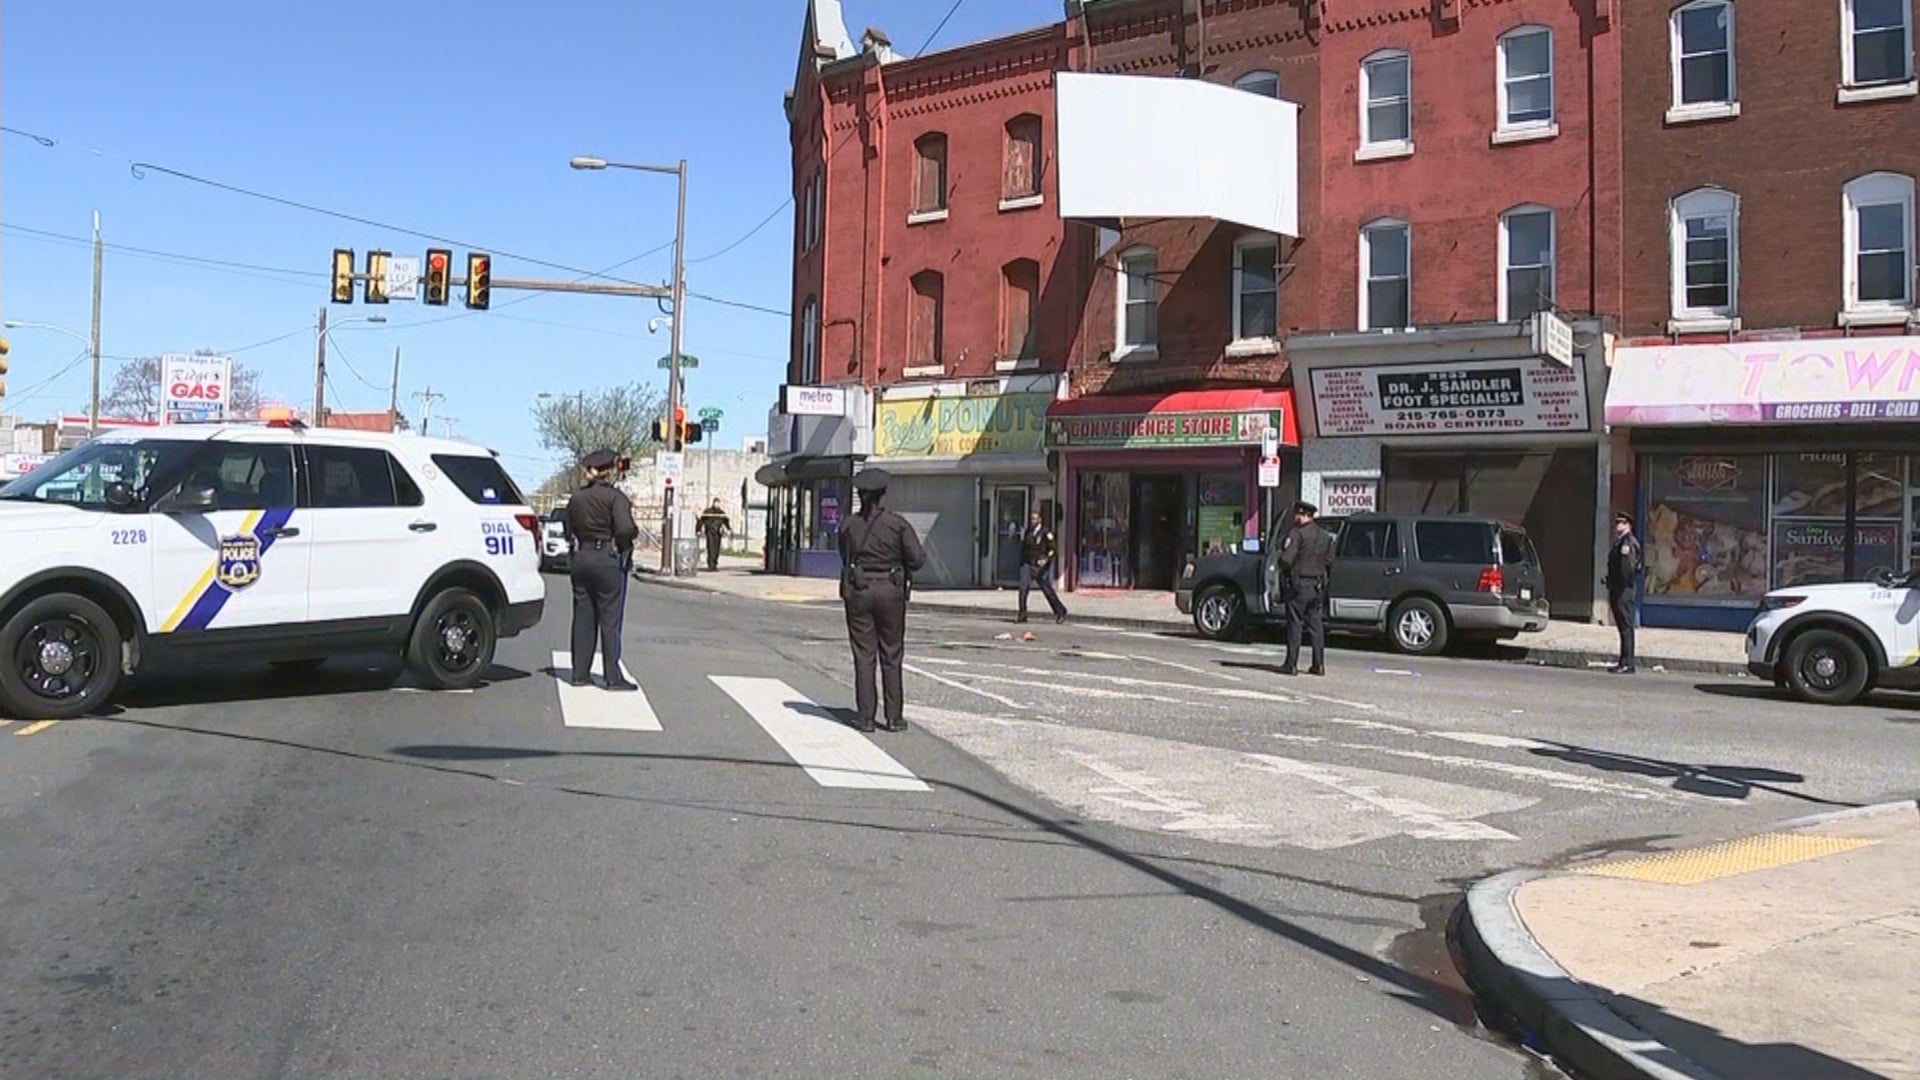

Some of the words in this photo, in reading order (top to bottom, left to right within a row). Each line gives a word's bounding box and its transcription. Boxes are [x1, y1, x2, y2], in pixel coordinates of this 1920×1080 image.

[394, 263, 409, 272] NO
[170, 383, 221, 400] GAS
[1388, 383, 1414, 394] DR.
[1420, 382, 1434, 393] J.
[1440, 378, 1511, 392] SANDLER
[800, 390, 833, 403] metro
[1383, 395, 1423, 407] FOOT
[1430, 392, 1519, 407] SPECIALIST
[939, 394, 1044, 433] DONUTS
[1397, 409, 1505, 420] 215-765-0873
[1775, 402, 1842, 419] GROCERIES
[1850, 402, 1877, 417] DELI
[1886, 400, 1919, 417] COLD
[1070, 418, 1176, 438] CONVENIENCE
[1182, 415, 1232, 436] STORE
[1384, 421, 1436, 430] BOARD
[1444, 420, 1525, 430] CERTIFIED
[959, 436, 993, 451] COFFEE
[1333, 483, 1368, 495] FOOT
[1328, 495, 1373, 507] DOCTOR
[481, 522, 513, 535] DIAL
[485, 536, 514, 555] 911
[222, 547, 256, 562] POLICE
